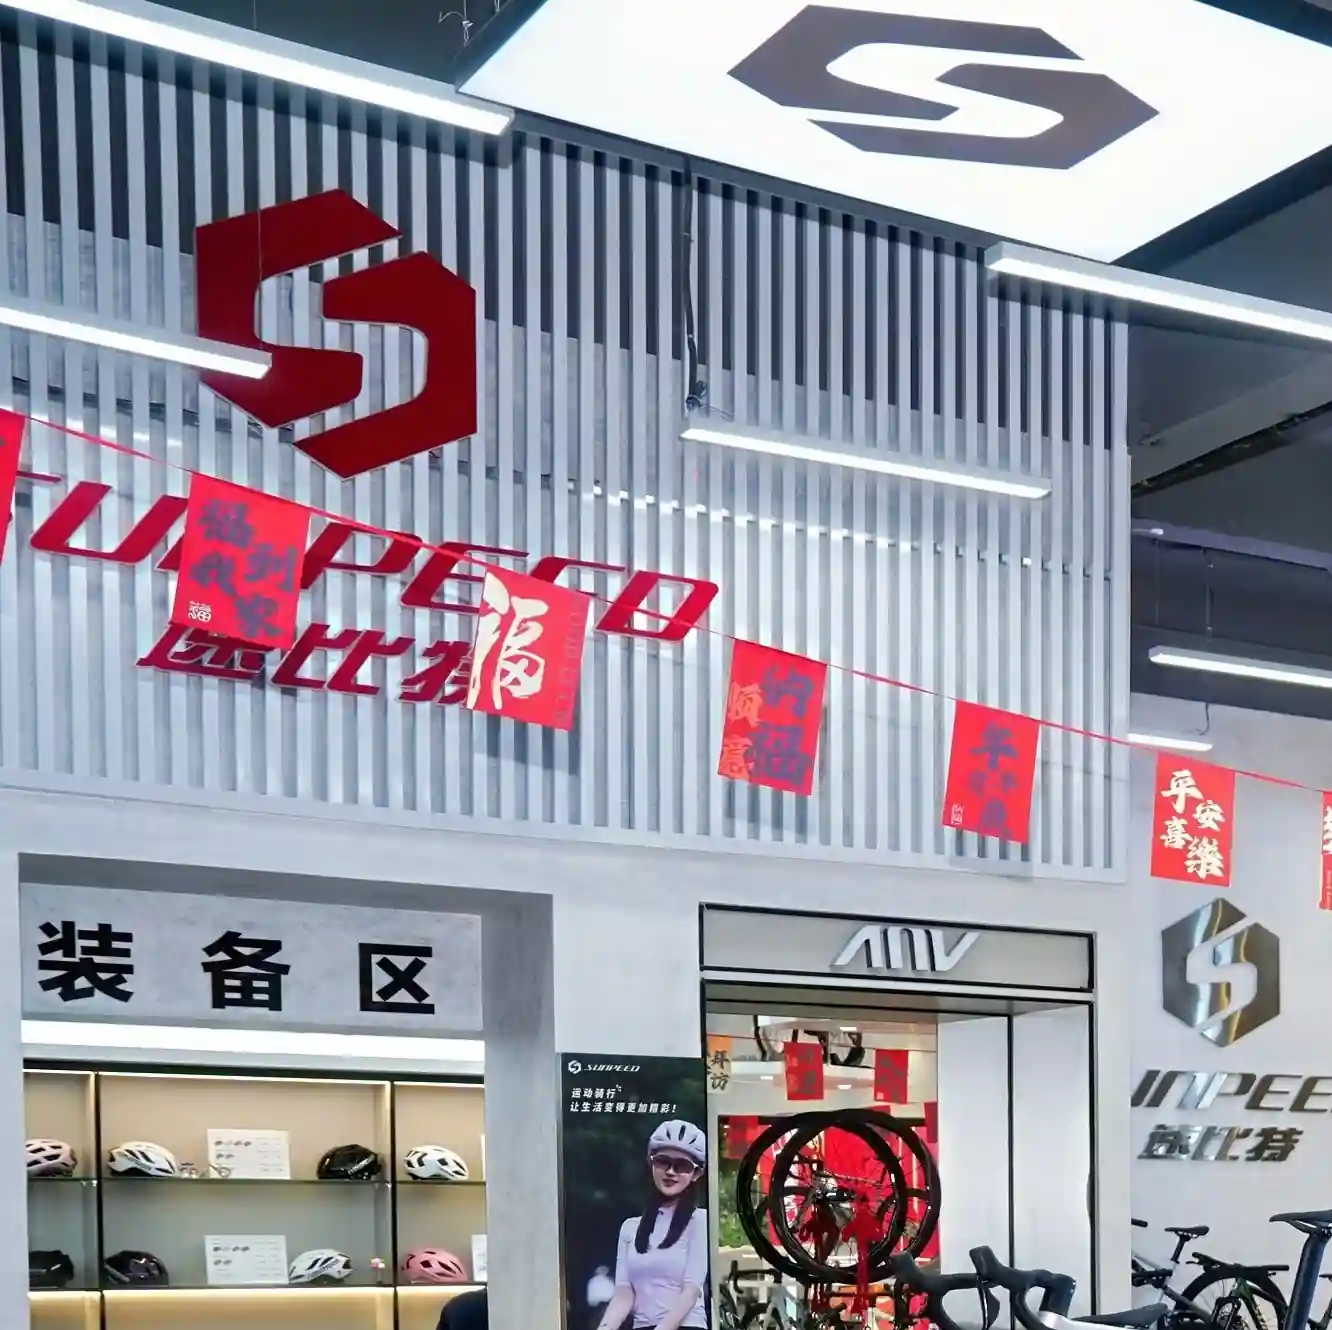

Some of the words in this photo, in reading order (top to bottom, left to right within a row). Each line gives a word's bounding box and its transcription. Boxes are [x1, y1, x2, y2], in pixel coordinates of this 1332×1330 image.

[14, 468, 719, 641] UPED
[467, 572, 549, 710] 福
[38, 920, 436, 1015] 装备区
[571, 1087, 617, 1099] 运动骑行
[584, 1064, 640, 1072] SUNPEED
